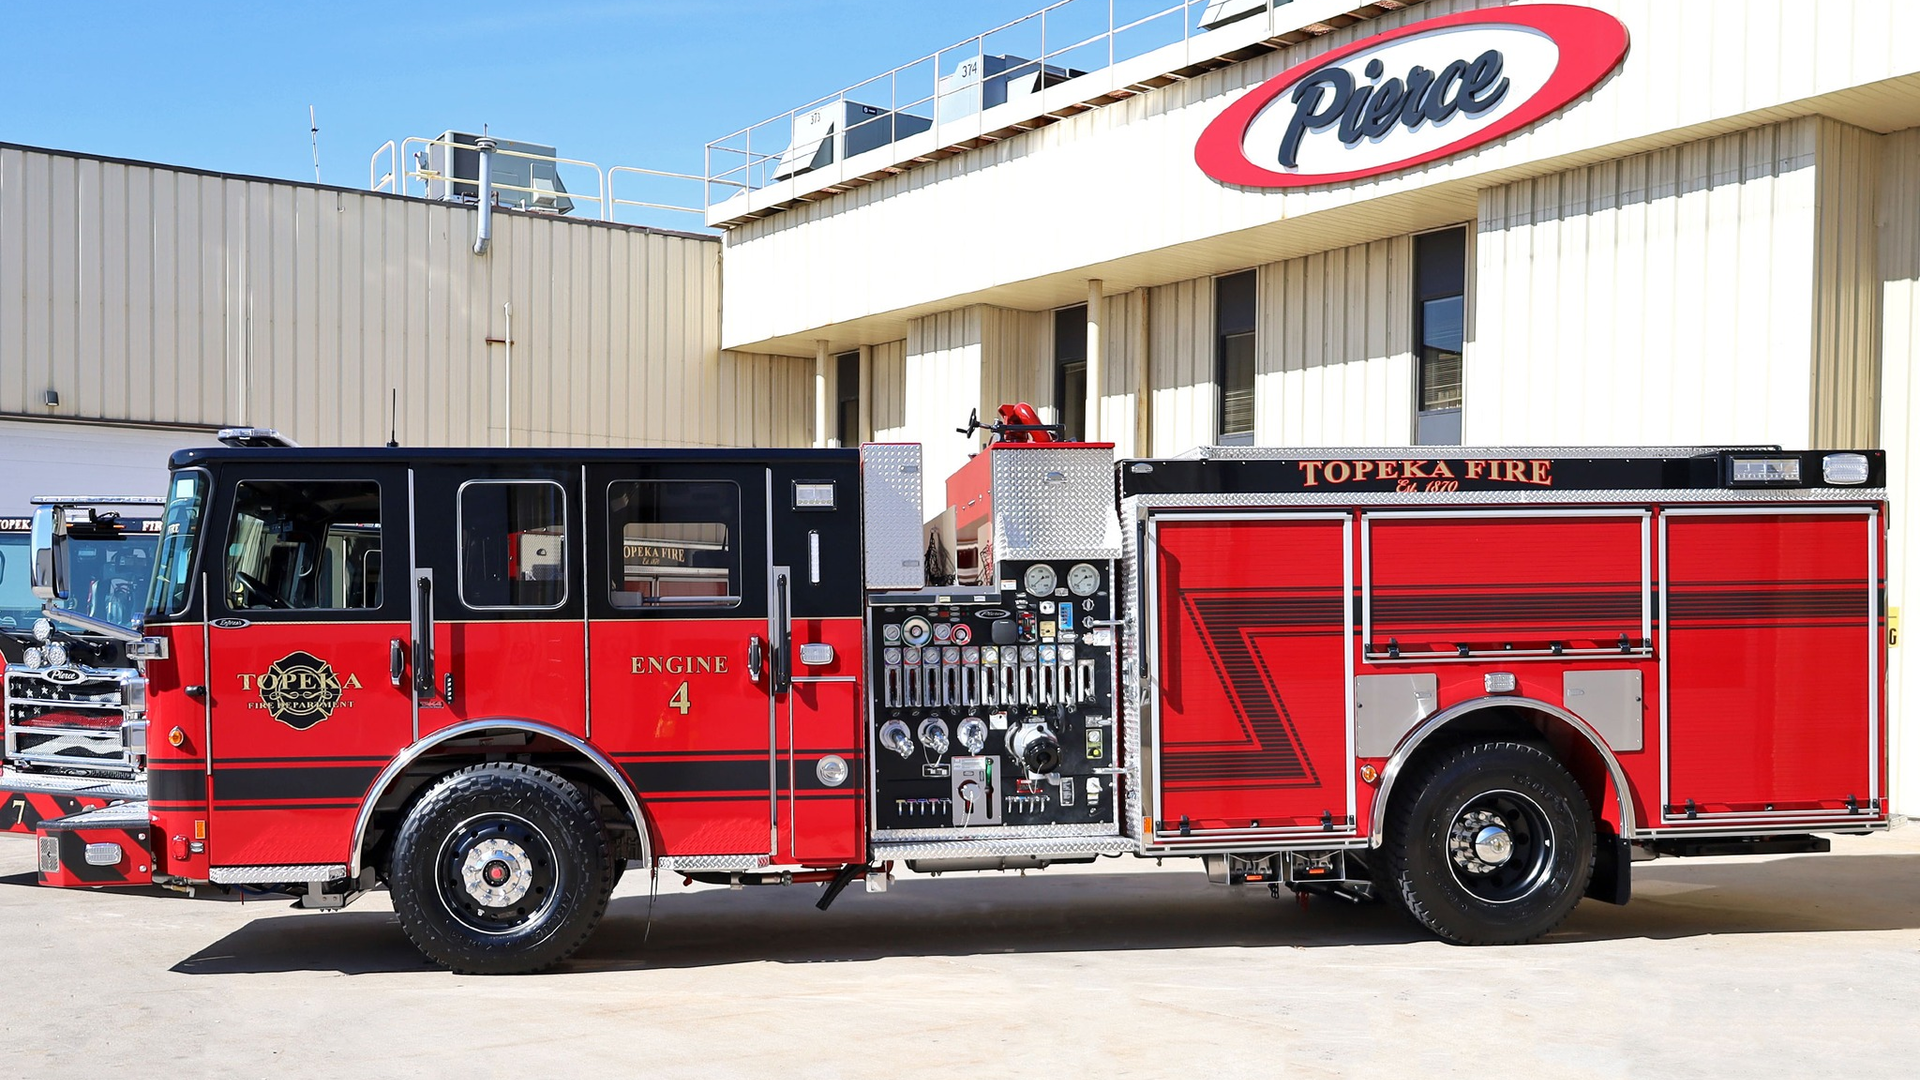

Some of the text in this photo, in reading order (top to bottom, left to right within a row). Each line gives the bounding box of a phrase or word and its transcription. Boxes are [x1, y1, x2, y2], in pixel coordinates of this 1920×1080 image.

[961, 61, 978, 78] 374
[1278, 49, 1510, 170] Pierce
[1298, 460, 1553, 487] TOPEKA FIRE
[1395, 479, 1459, 493] Est. 1870
[0, 519, 163, 531] OPEK FIR
[623, 545, 659, 559] OPEKA
[661, 547, 685, 563] FIRE
[1889, 628, 1897, 645] G
[630, 656, 729, 674] ENGINE
[50, 670, 77, 681] Pierce
[236, 672, 363, 692] TOPEKA
[247, 700, 355, 710] FIRE DEPARTMENT
[669, 681, 691, 715] 4
[12, 799, 26, 825] 7
